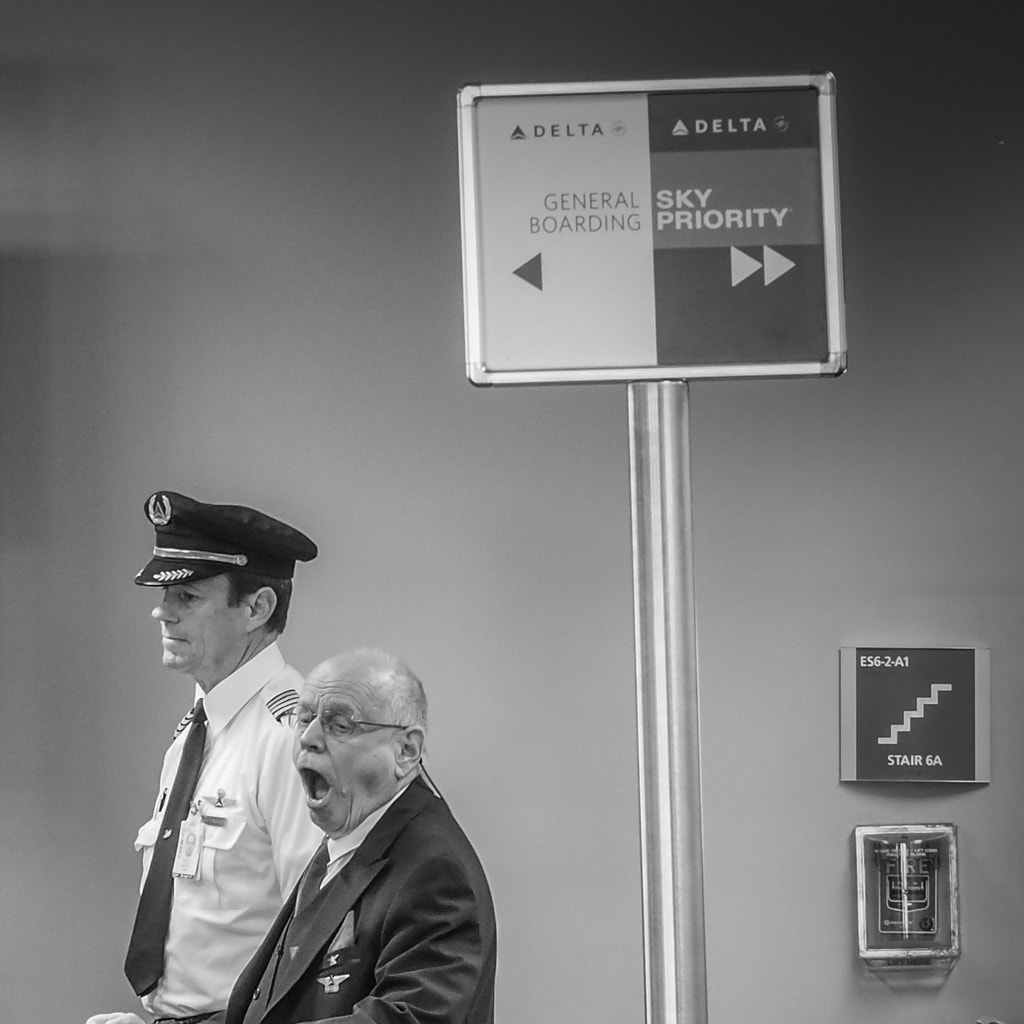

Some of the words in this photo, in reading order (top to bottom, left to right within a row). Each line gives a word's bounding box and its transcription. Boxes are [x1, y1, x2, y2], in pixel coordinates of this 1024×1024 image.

[533, 123, 604, 138] DELTA
[695, 117, 767, 134] DELTA
[543, 191, 640, 212] GENERAL
[656, 188, 712, 208] SKY
[529, 213, 642, 234] BOARDING
[656, 206, 788, 231] PRIORITY
[860, 655, 910, 668] ES6-2-A1
[887, 754, 923, 767] STAIR
[925, 754, 943, 767] 6A
[886, 858, 929, 874] FRE
